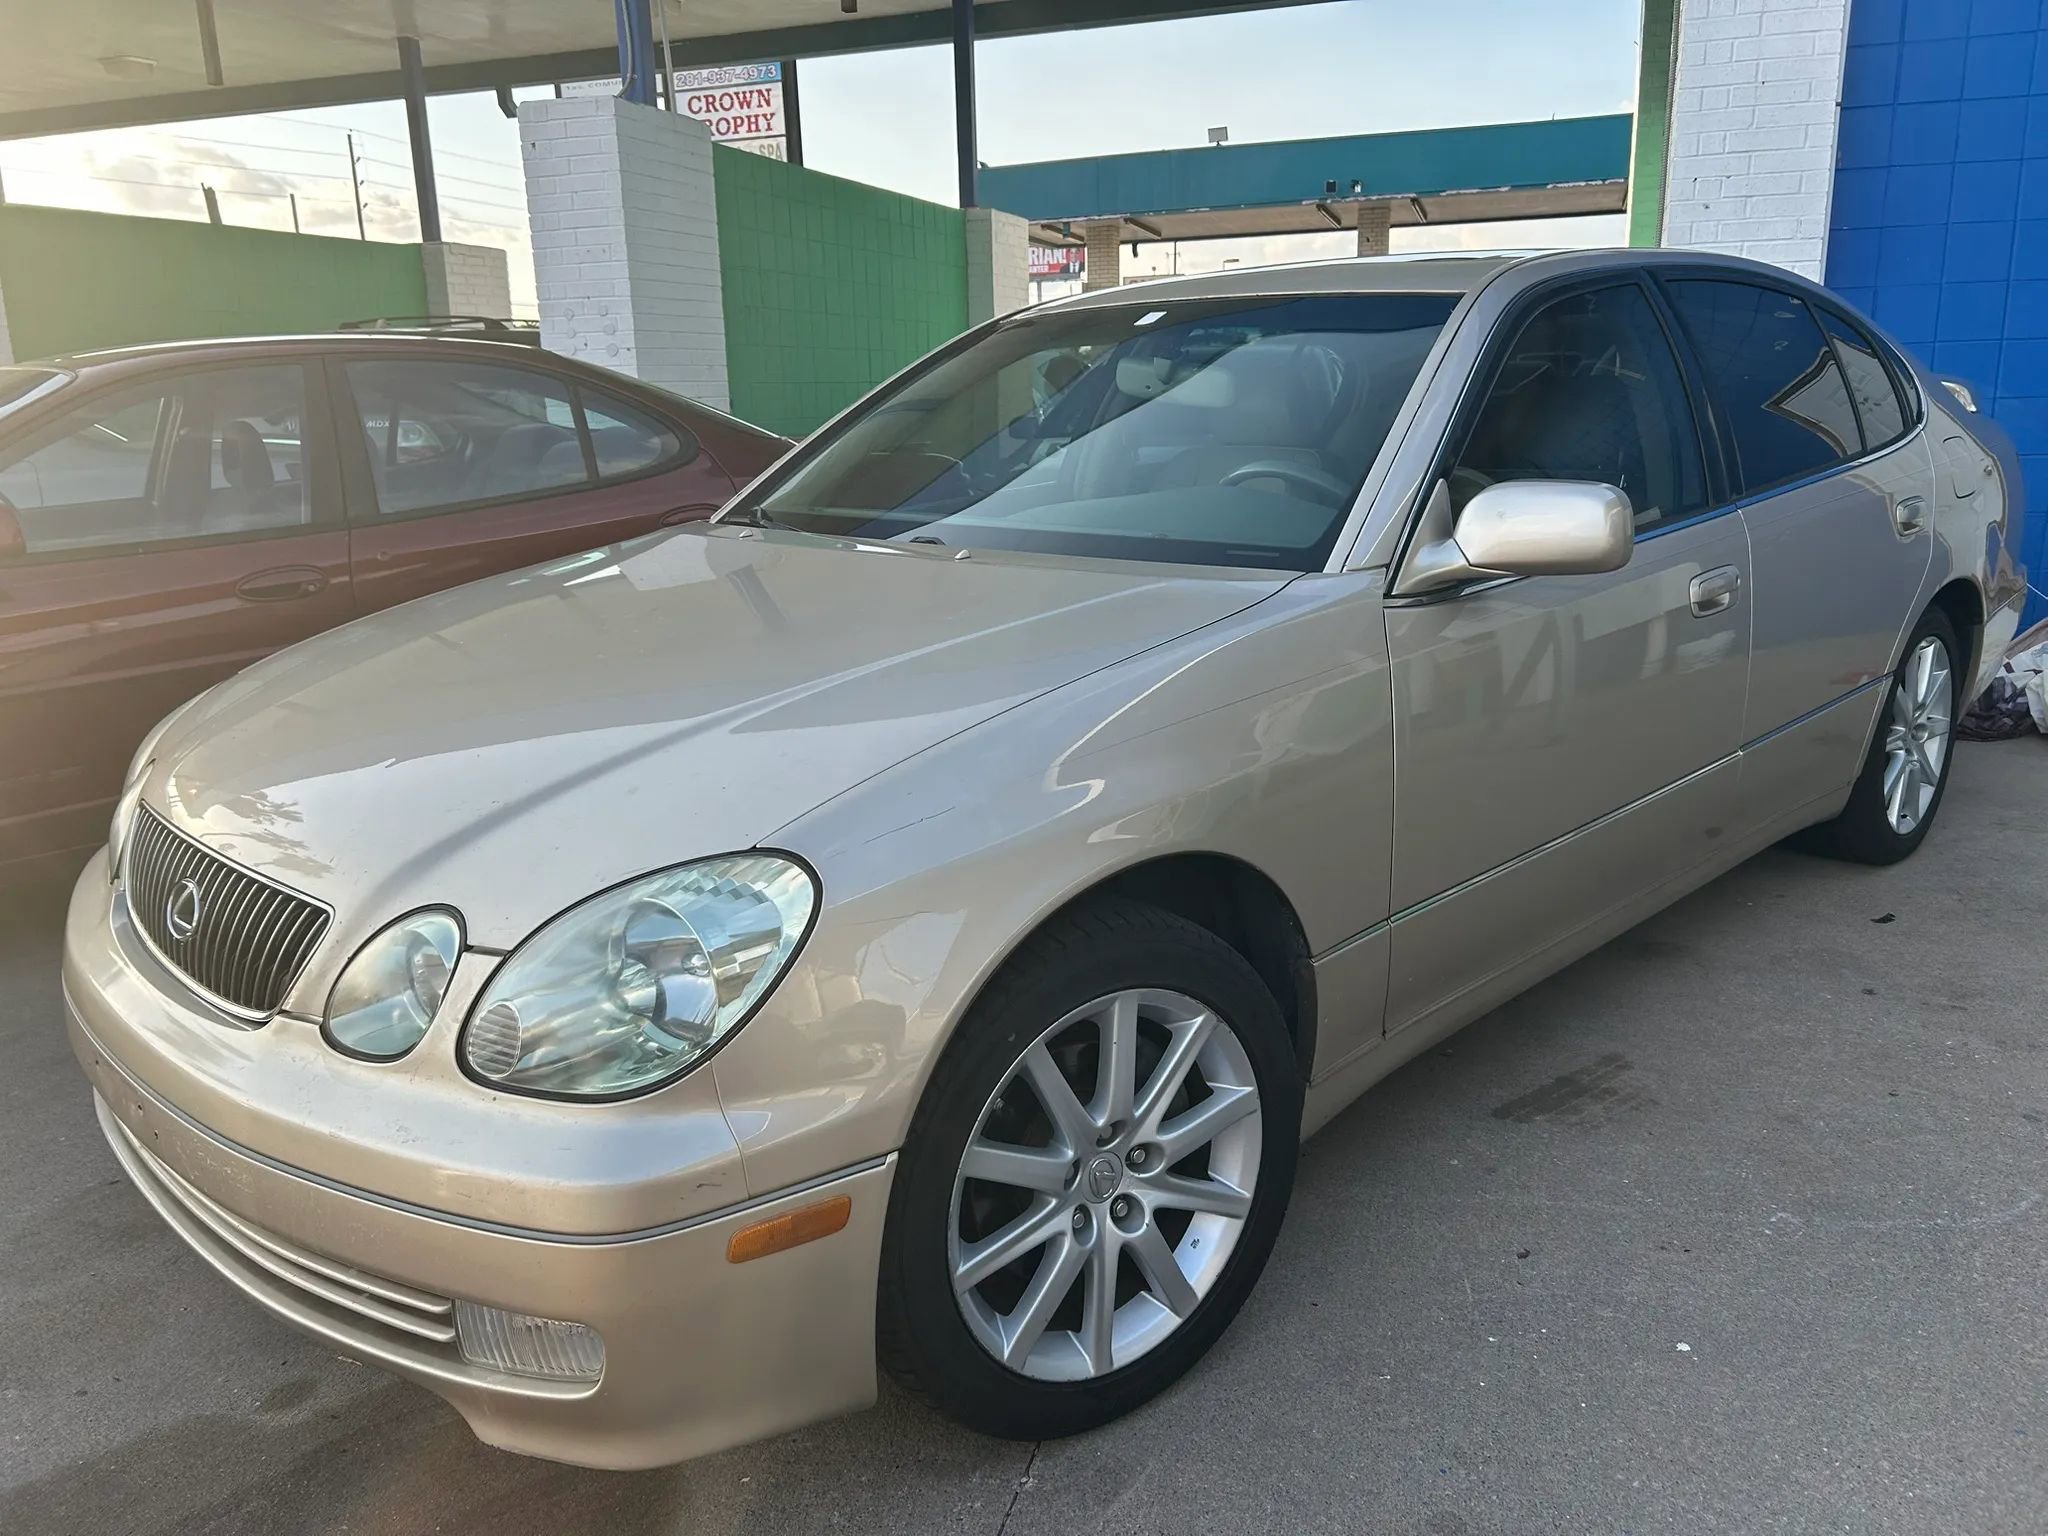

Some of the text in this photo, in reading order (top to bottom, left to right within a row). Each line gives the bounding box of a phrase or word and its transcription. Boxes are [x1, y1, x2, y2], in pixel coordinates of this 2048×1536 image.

[676, 64, 776, 88] 281-937-4973
[688, 89, 772, 115] CROWN
[704, 112, 775, 137] ROPHY
[759, 142, 783, 161] SPA
[1028, 246, 1067, 265] RIAN!
